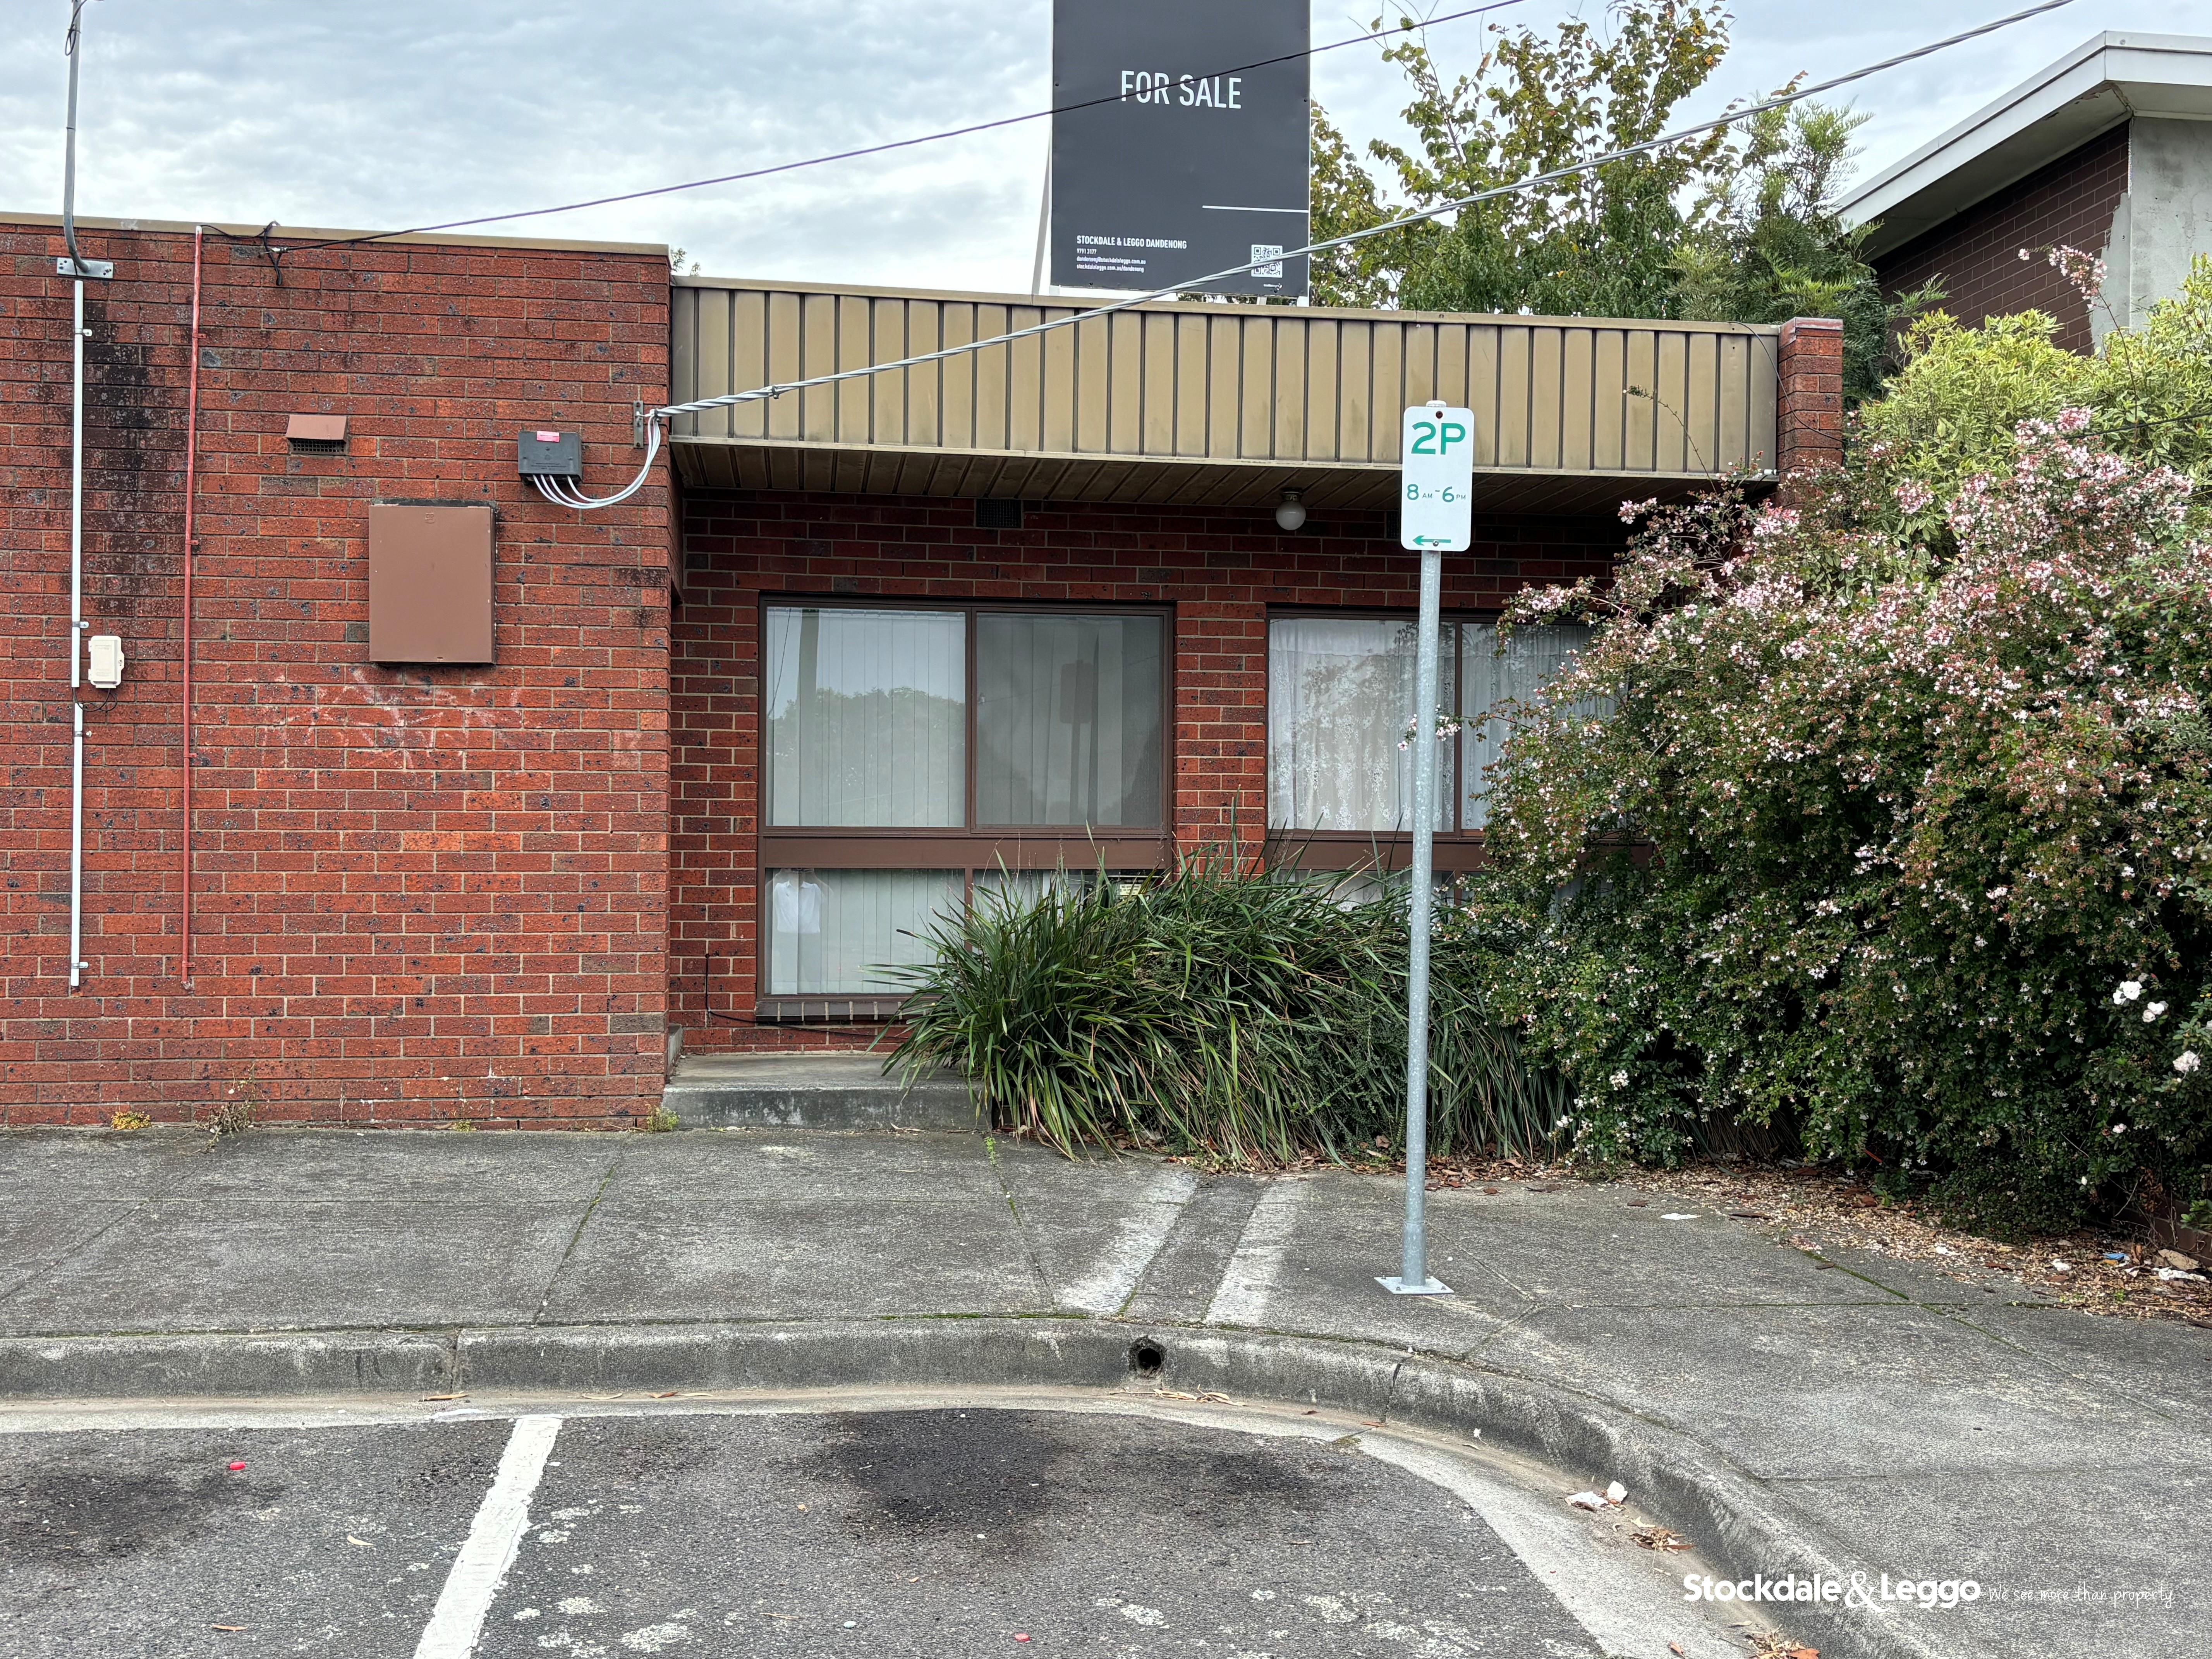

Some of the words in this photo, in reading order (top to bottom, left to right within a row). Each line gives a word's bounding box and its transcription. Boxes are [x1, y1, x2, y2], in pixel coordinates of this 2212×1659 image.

[1121, 70, 1170, 105] FOR
[1179, 74, 1242, 109] SALE
[1077, 235, 1115, 246] STOCKDALE
[1117, 237, 1122, 246] &
[1123, 237, 1145, 247] LEGGO
[1146, 239, 1187, 249] DANDENONG
[1411, 421, 1466, 455] 2P
